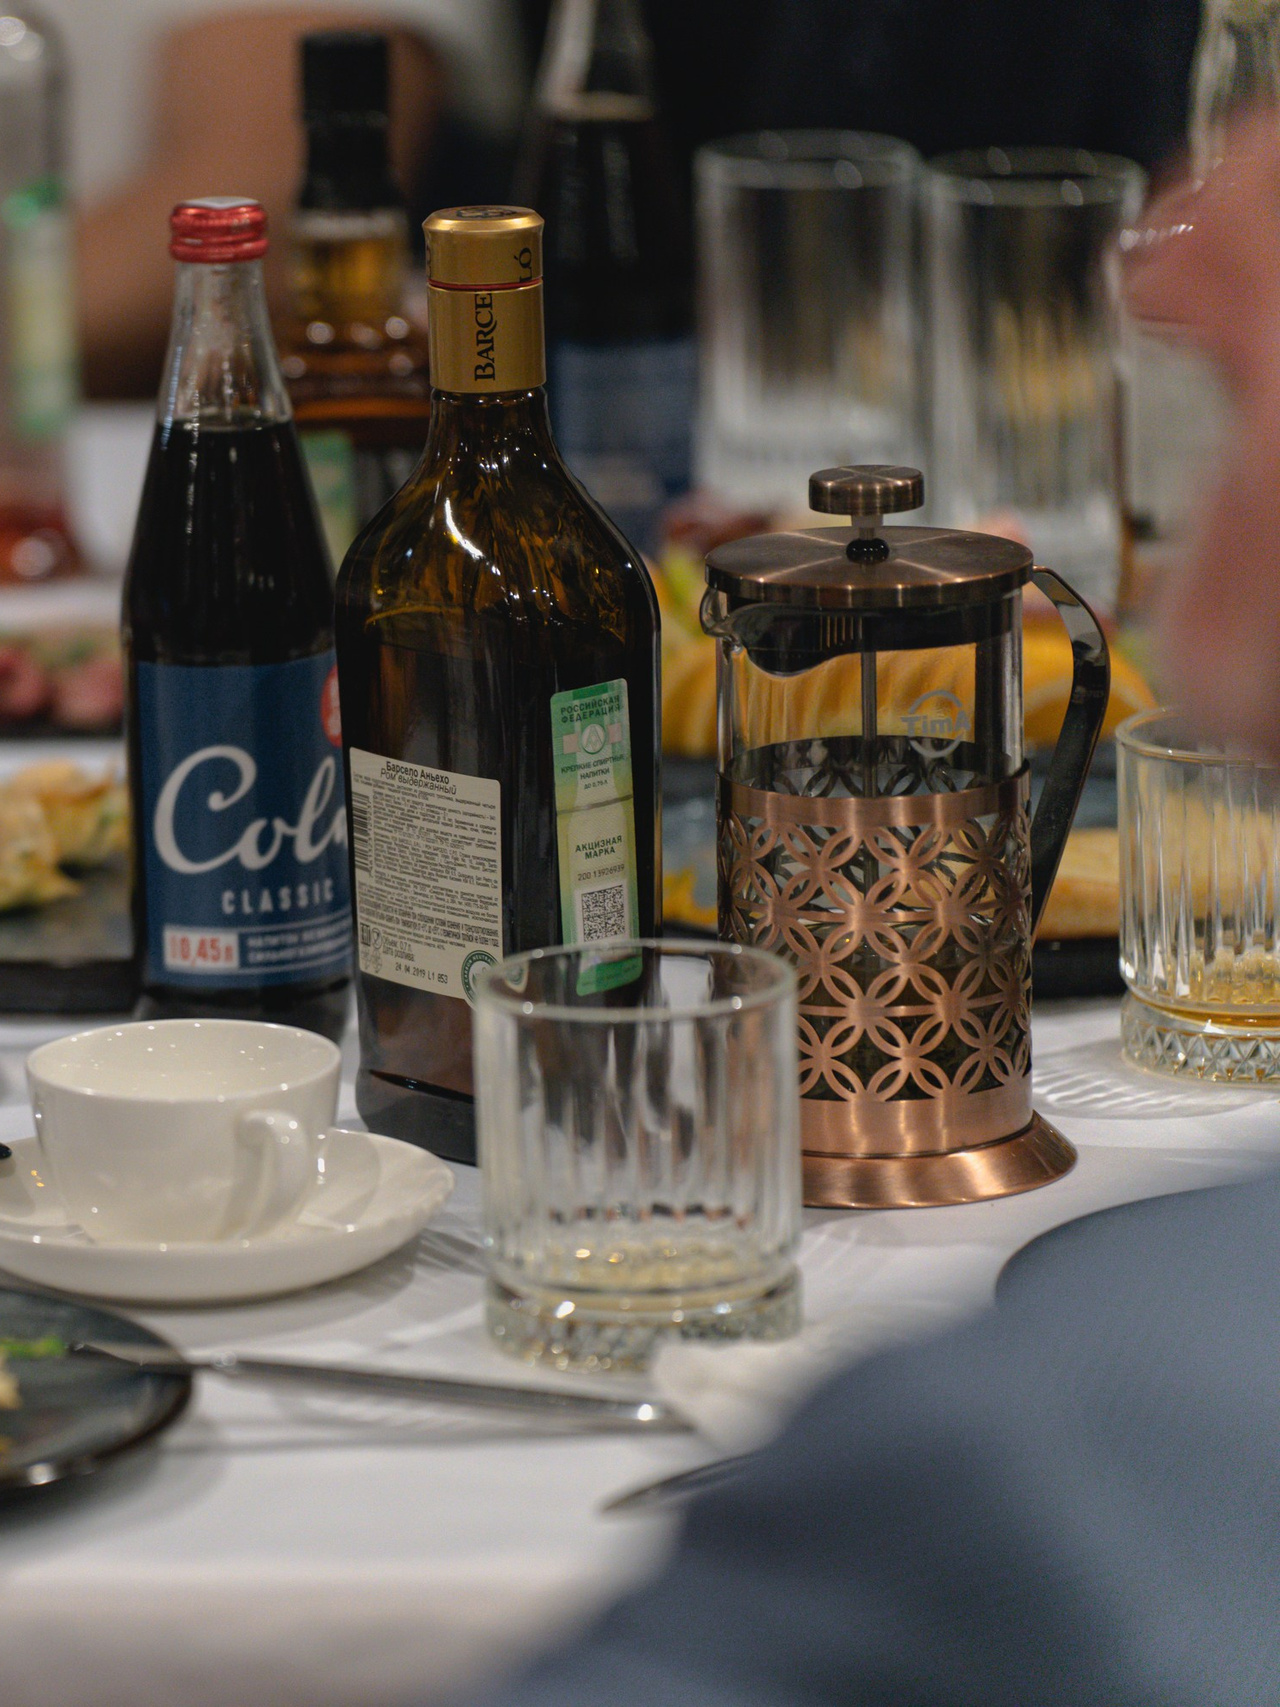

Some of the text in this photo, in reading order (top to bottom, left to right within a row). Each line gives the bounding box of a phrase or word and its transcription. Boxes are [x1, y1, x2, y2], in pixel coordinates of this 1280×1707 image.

[474, 292, 497, 381] BARCE
[561, 694, 620, 715] РОССИЙСКАЯ
[561, 703, 621, 724] ФЕДЕРАЦИЯ
[380, 768, 396, 780] Ром
[397, 775, 457, 795] выдержанный
[386, 761, 450, 785] Барсело Аньехо
[580, 767, 610, 780] НАПИТКИ
[575, 834, 622, 853] АКЦИЗНАЯ
[584, 846, 616, 860] МАРКА
[578, 872, 591, 881] 200
[221, 877, 334, 915] CLASSIC
